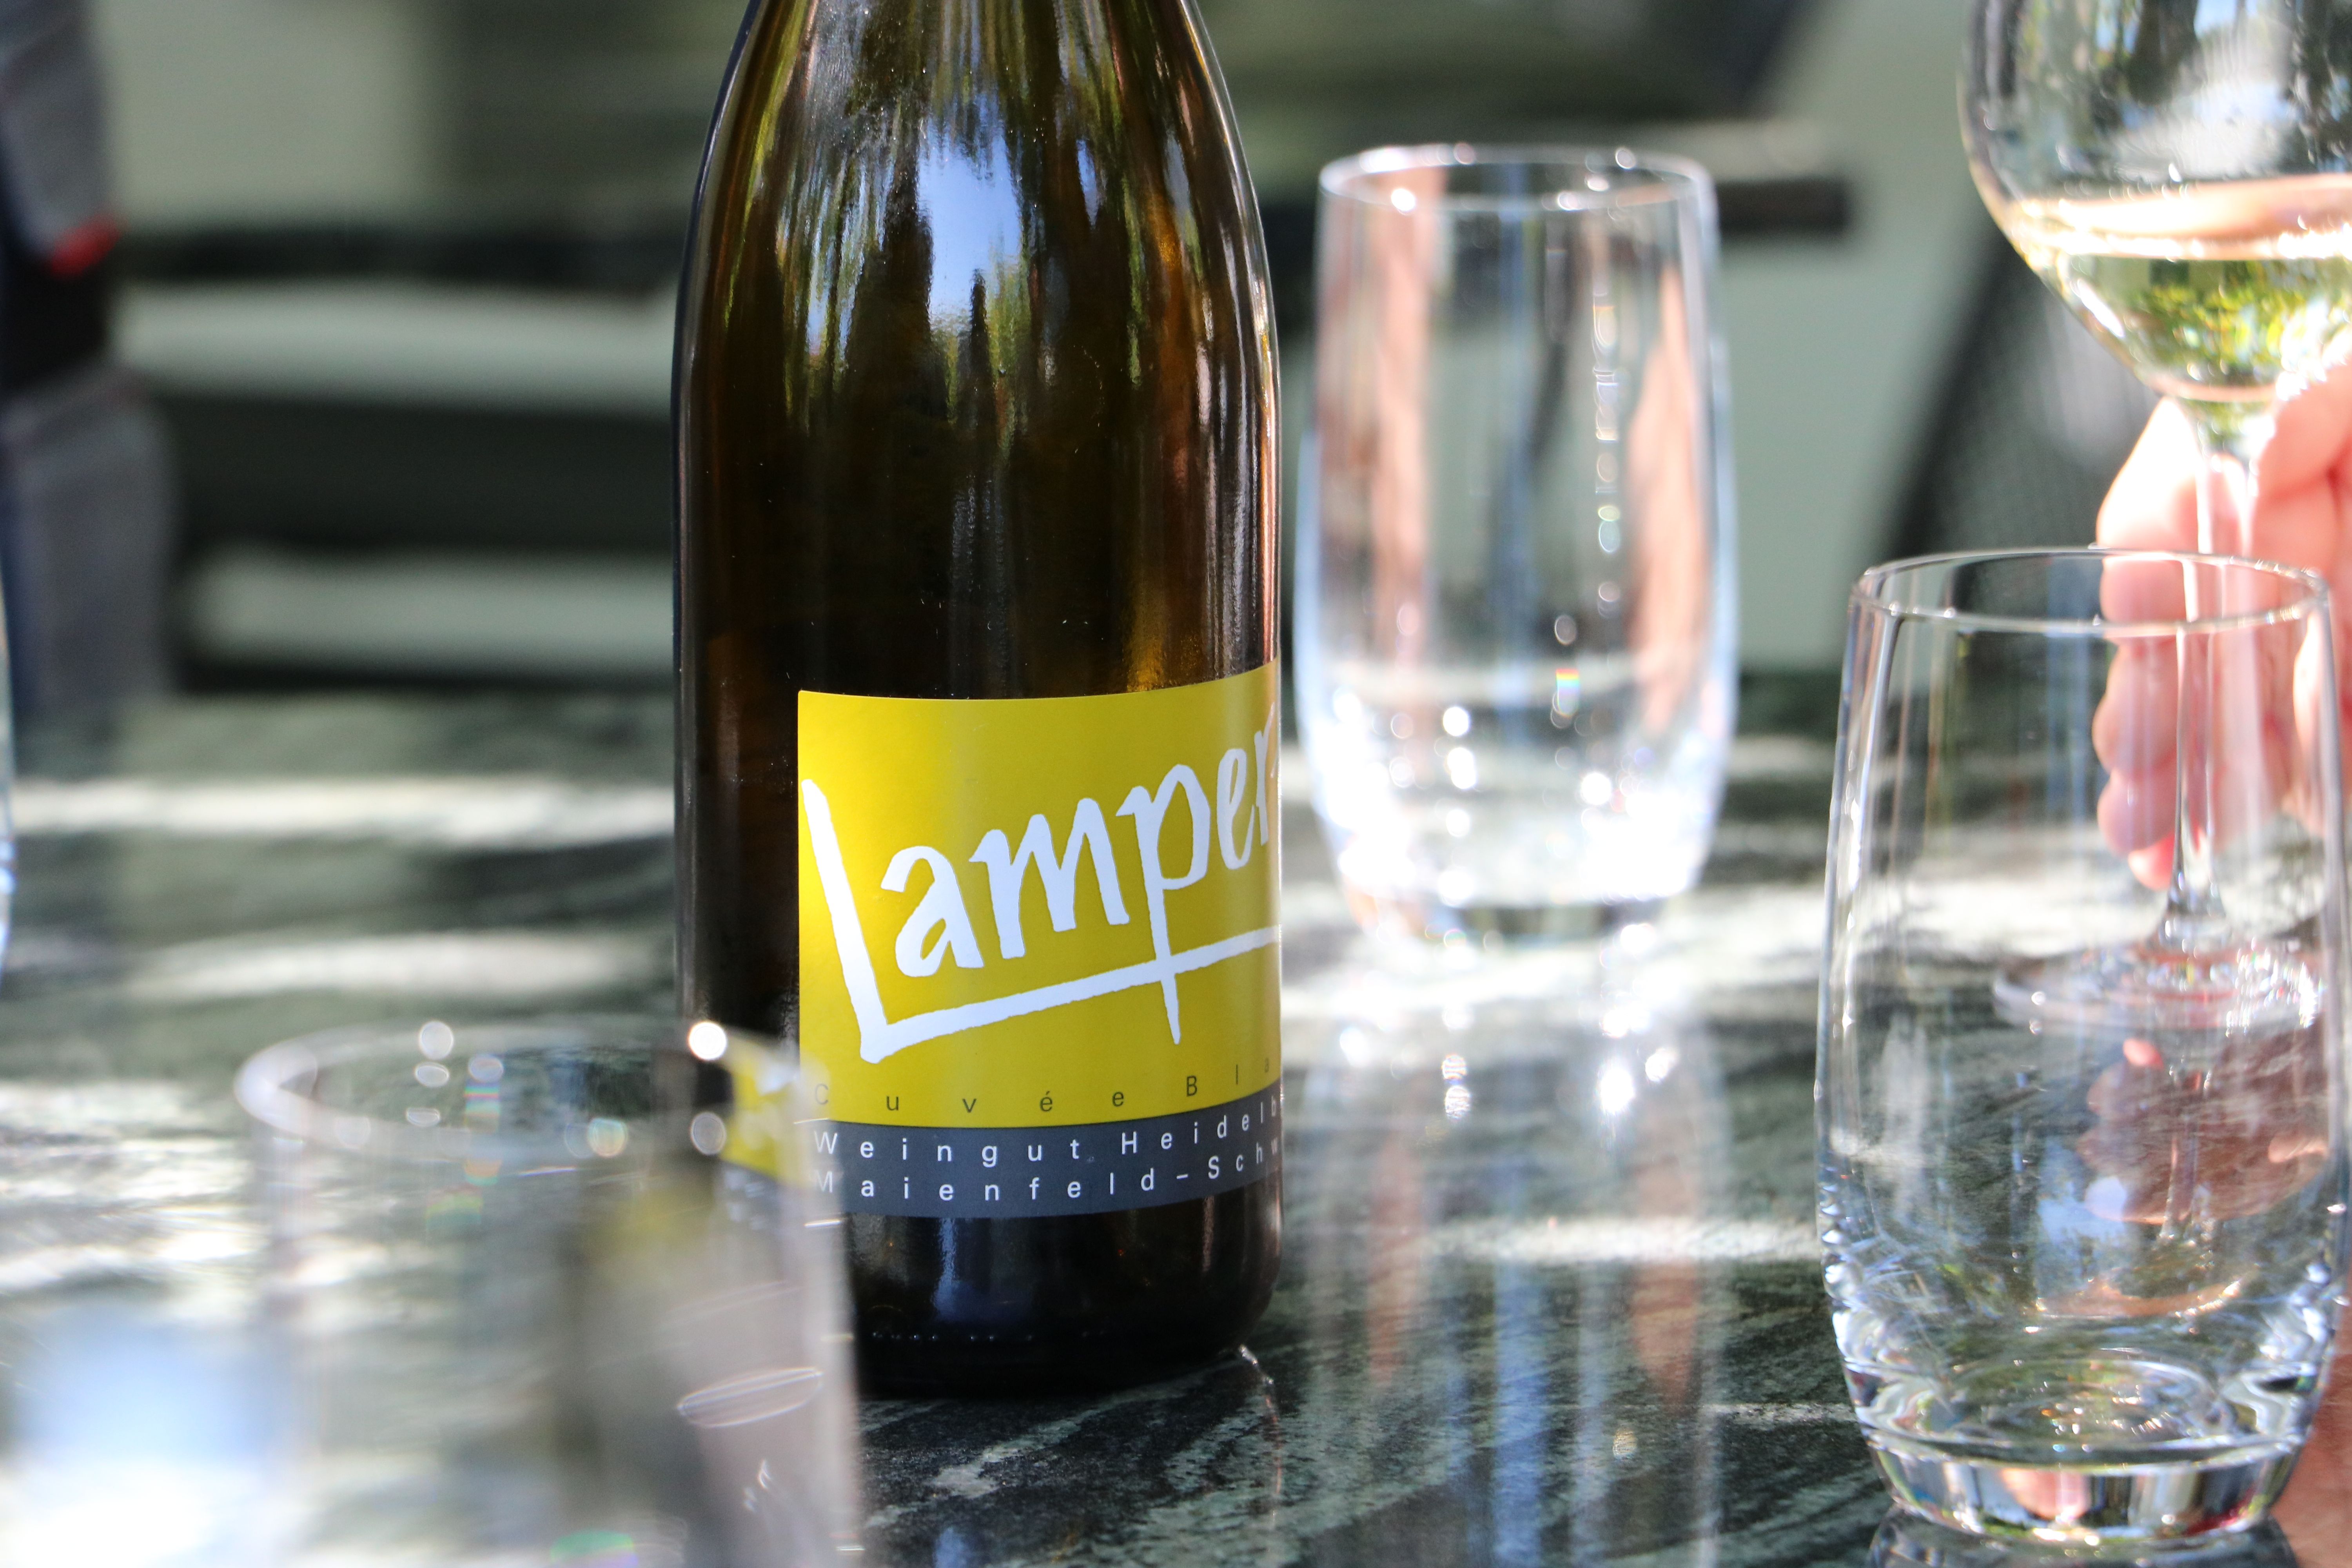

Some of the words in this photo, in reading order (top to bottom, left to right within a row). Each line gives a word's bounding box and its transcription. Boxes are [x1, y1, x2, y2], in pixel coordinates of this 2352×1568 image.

[815, 1083, 1124, 1113] Cuvée
[1186, 1058, 1269, 1097] Bla
[814, 1131, 1080, 1167] Weingut
